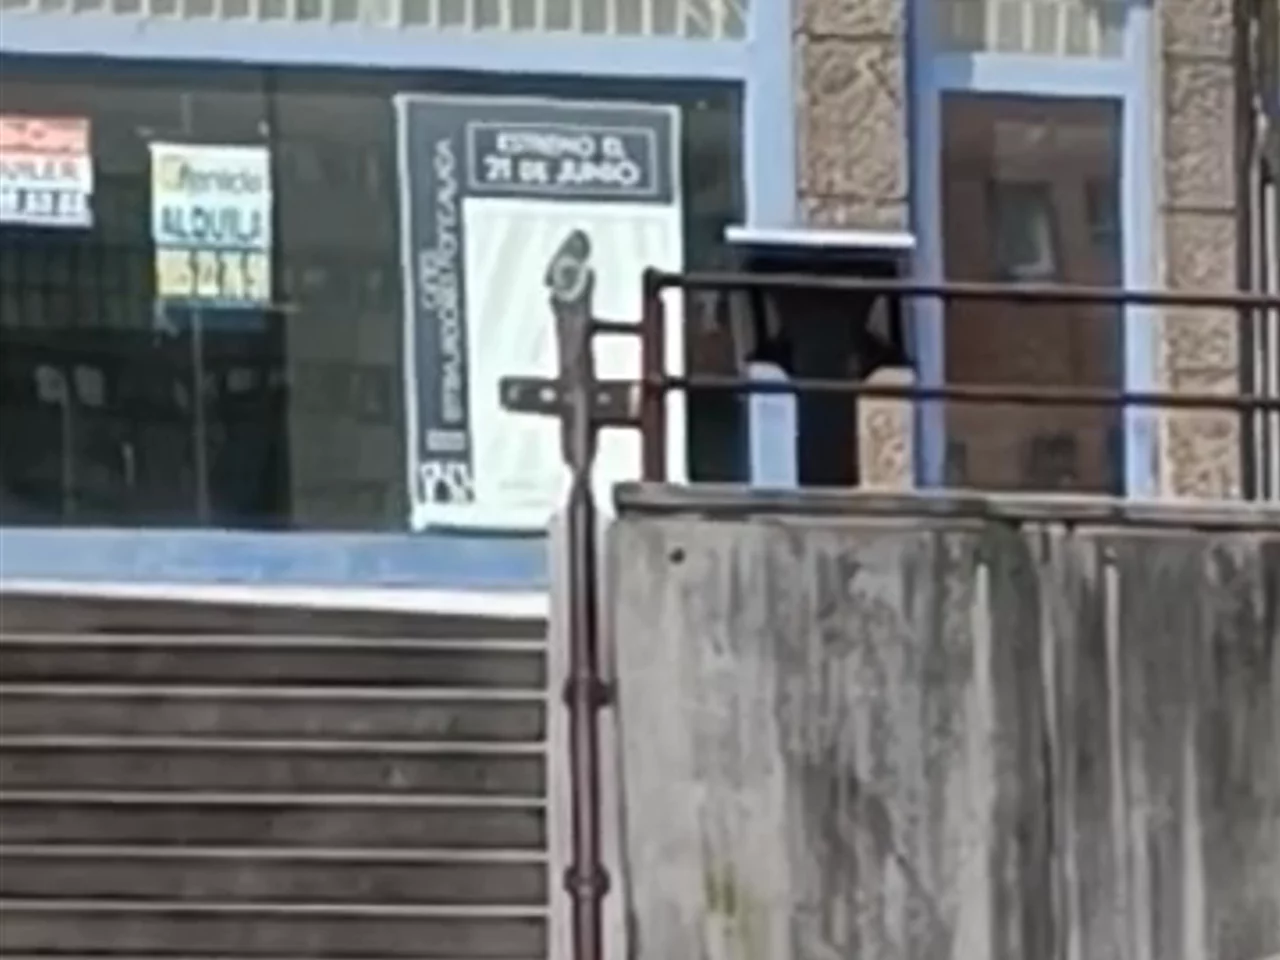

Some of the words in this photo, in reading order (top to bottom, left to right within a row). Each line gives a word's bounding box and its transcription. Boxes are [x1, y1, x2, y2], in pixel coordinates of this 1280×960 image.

[483, 154, 512, 180] 21
[519, 159, 549, 183] DE
[557, 158, 641, 187] JUNIO
